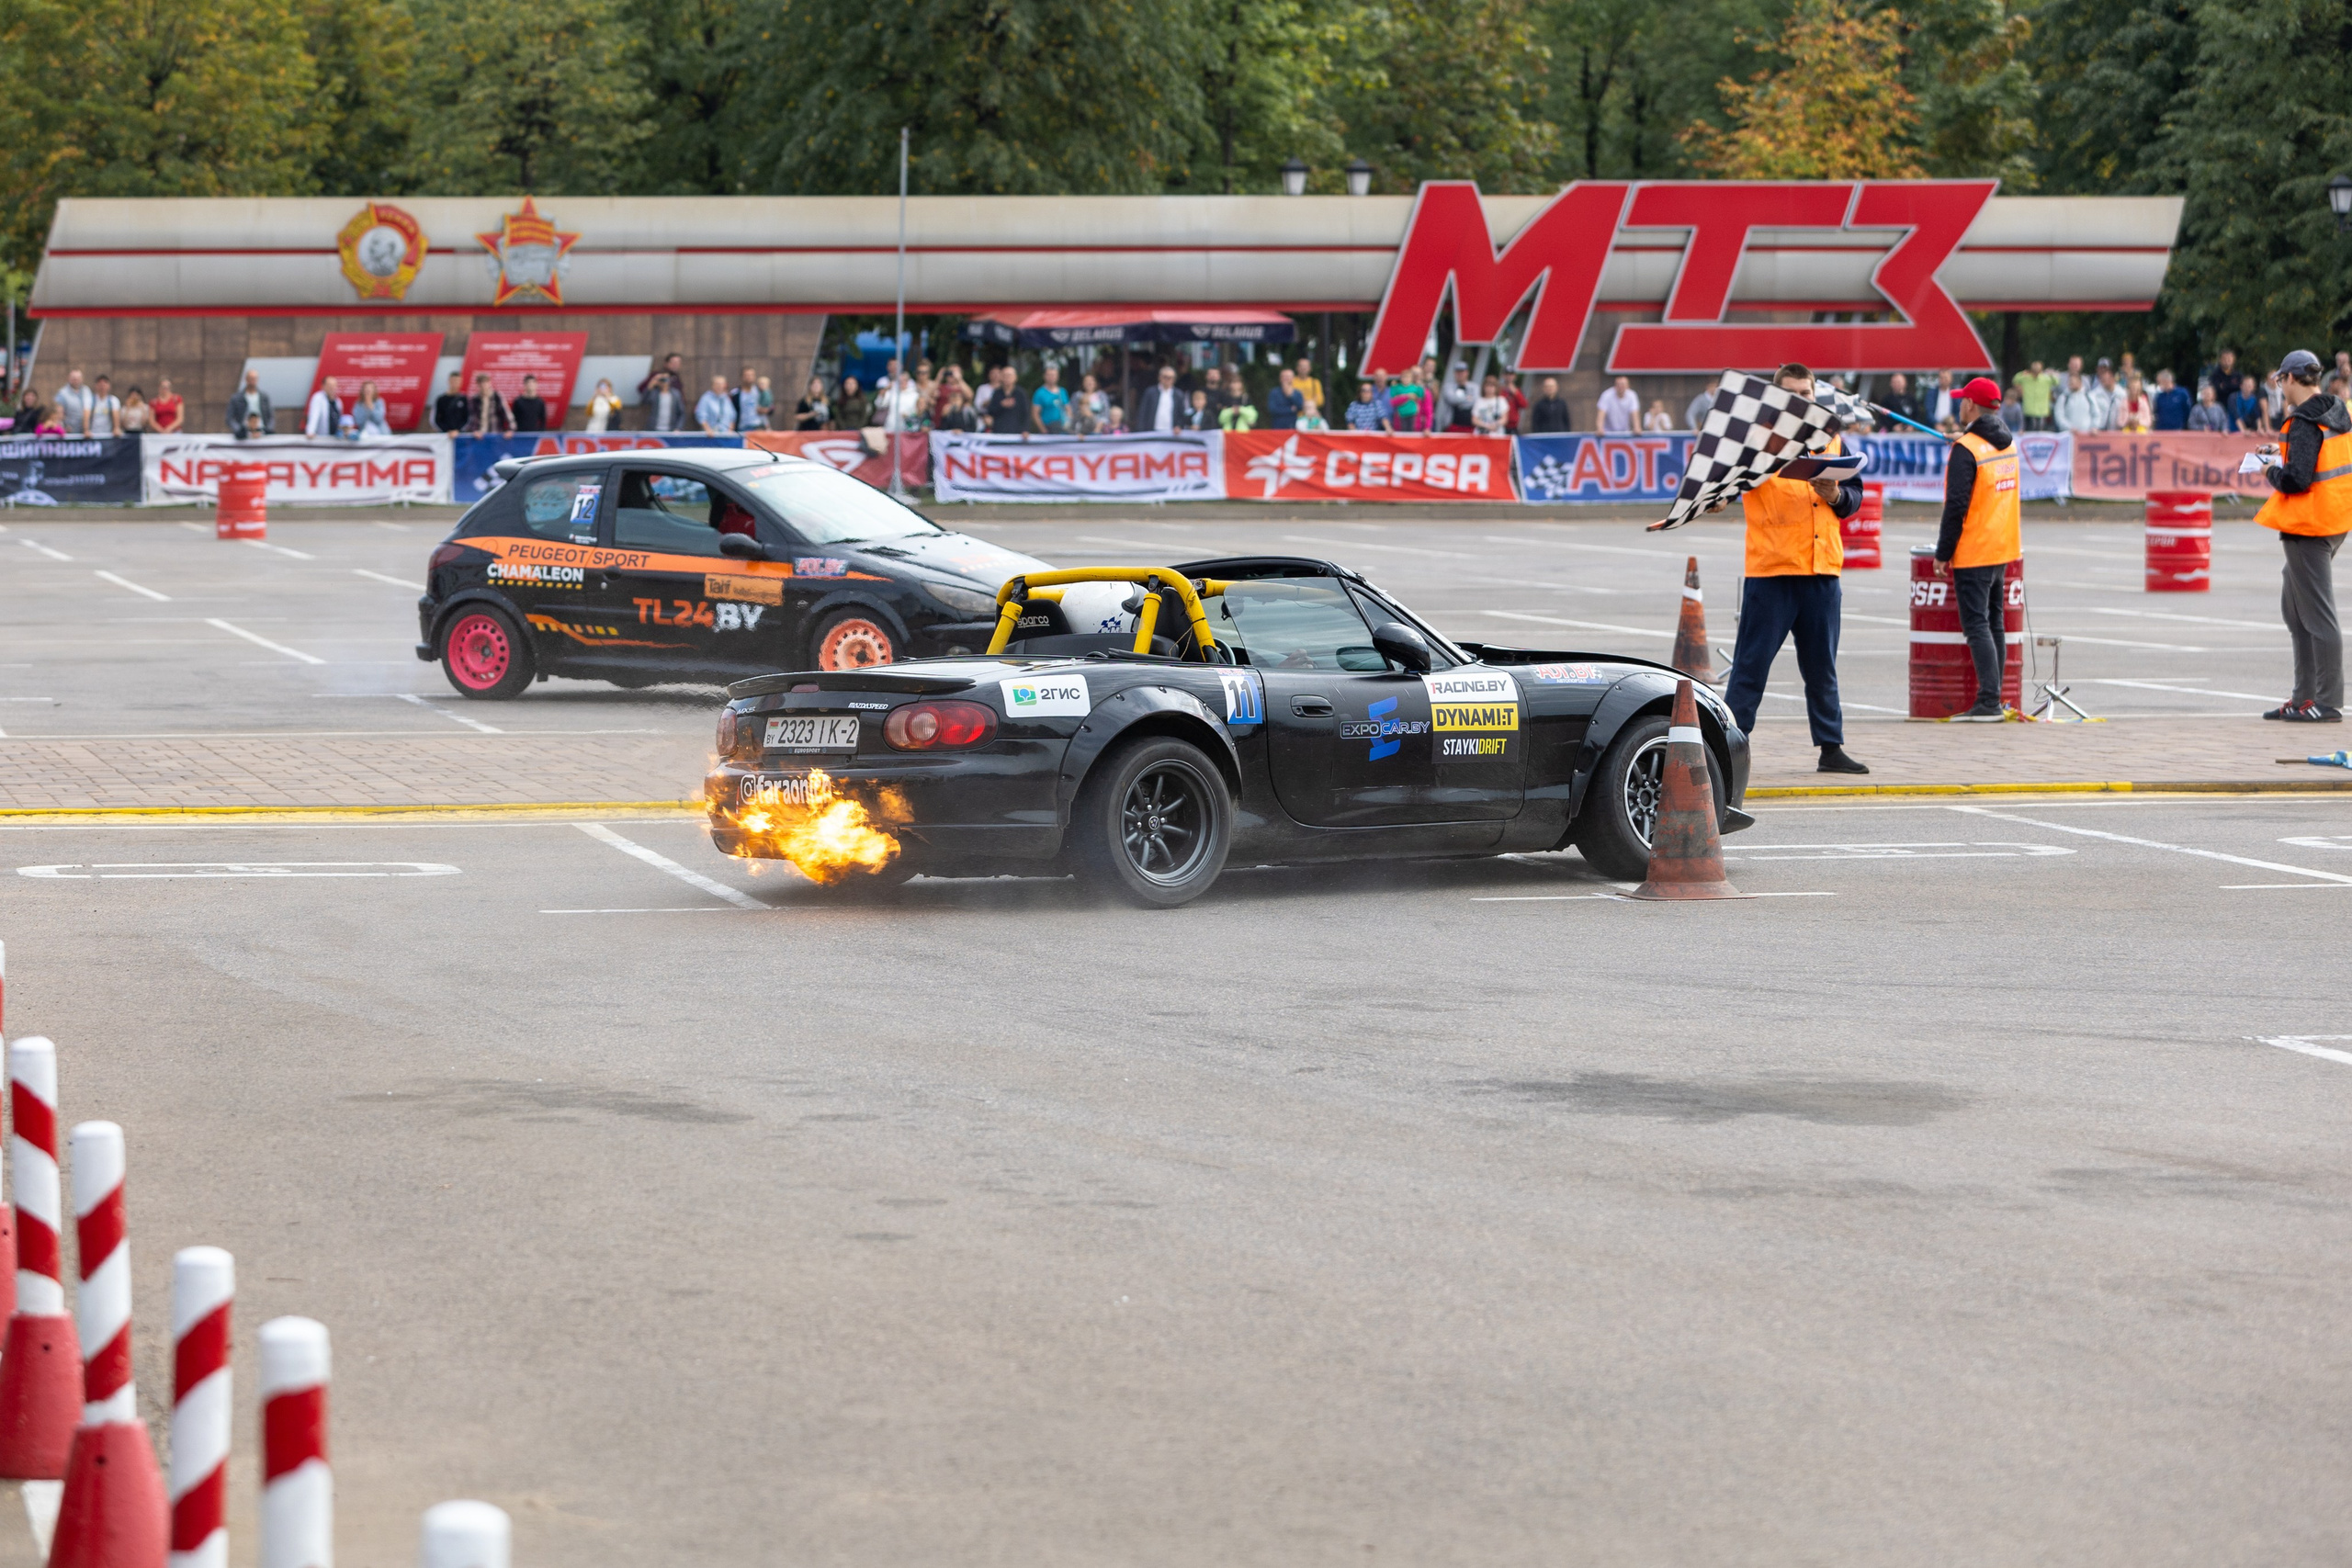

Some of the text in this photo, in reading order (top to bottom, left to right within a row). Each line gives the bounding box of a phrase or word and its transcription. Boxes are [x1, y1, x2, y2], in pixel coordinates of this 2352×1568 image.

[1362, 179, 2000, 375] МТЗ
[0, 441, 103, 458] ШИПНИКИ
[1860, 439, 1949, 475] DINIT
[160, 458, 436, 489] NAAYAMA
[944, 451, 1209, 481] NAKAYAMA
[1323, 450, 1491, 492] CEPSA
[1569, 438, 1694, 494] ADT.
[576, 498, 595, 520] 12
[508, 543, 651, 569] PEUGEOT SPORT
[1017, 615, 1050, 628] sparco
[1537, 664, 1597, 679] ADT.BY
[847, 702, 889, 710] MAZDASPEED
[1040, 688, 1081, 700] 2ГИС
[1228, 679, 1256, 718] 11
[766, 734, 775, 744] BY
[778, 719, 816, 744] 2323
